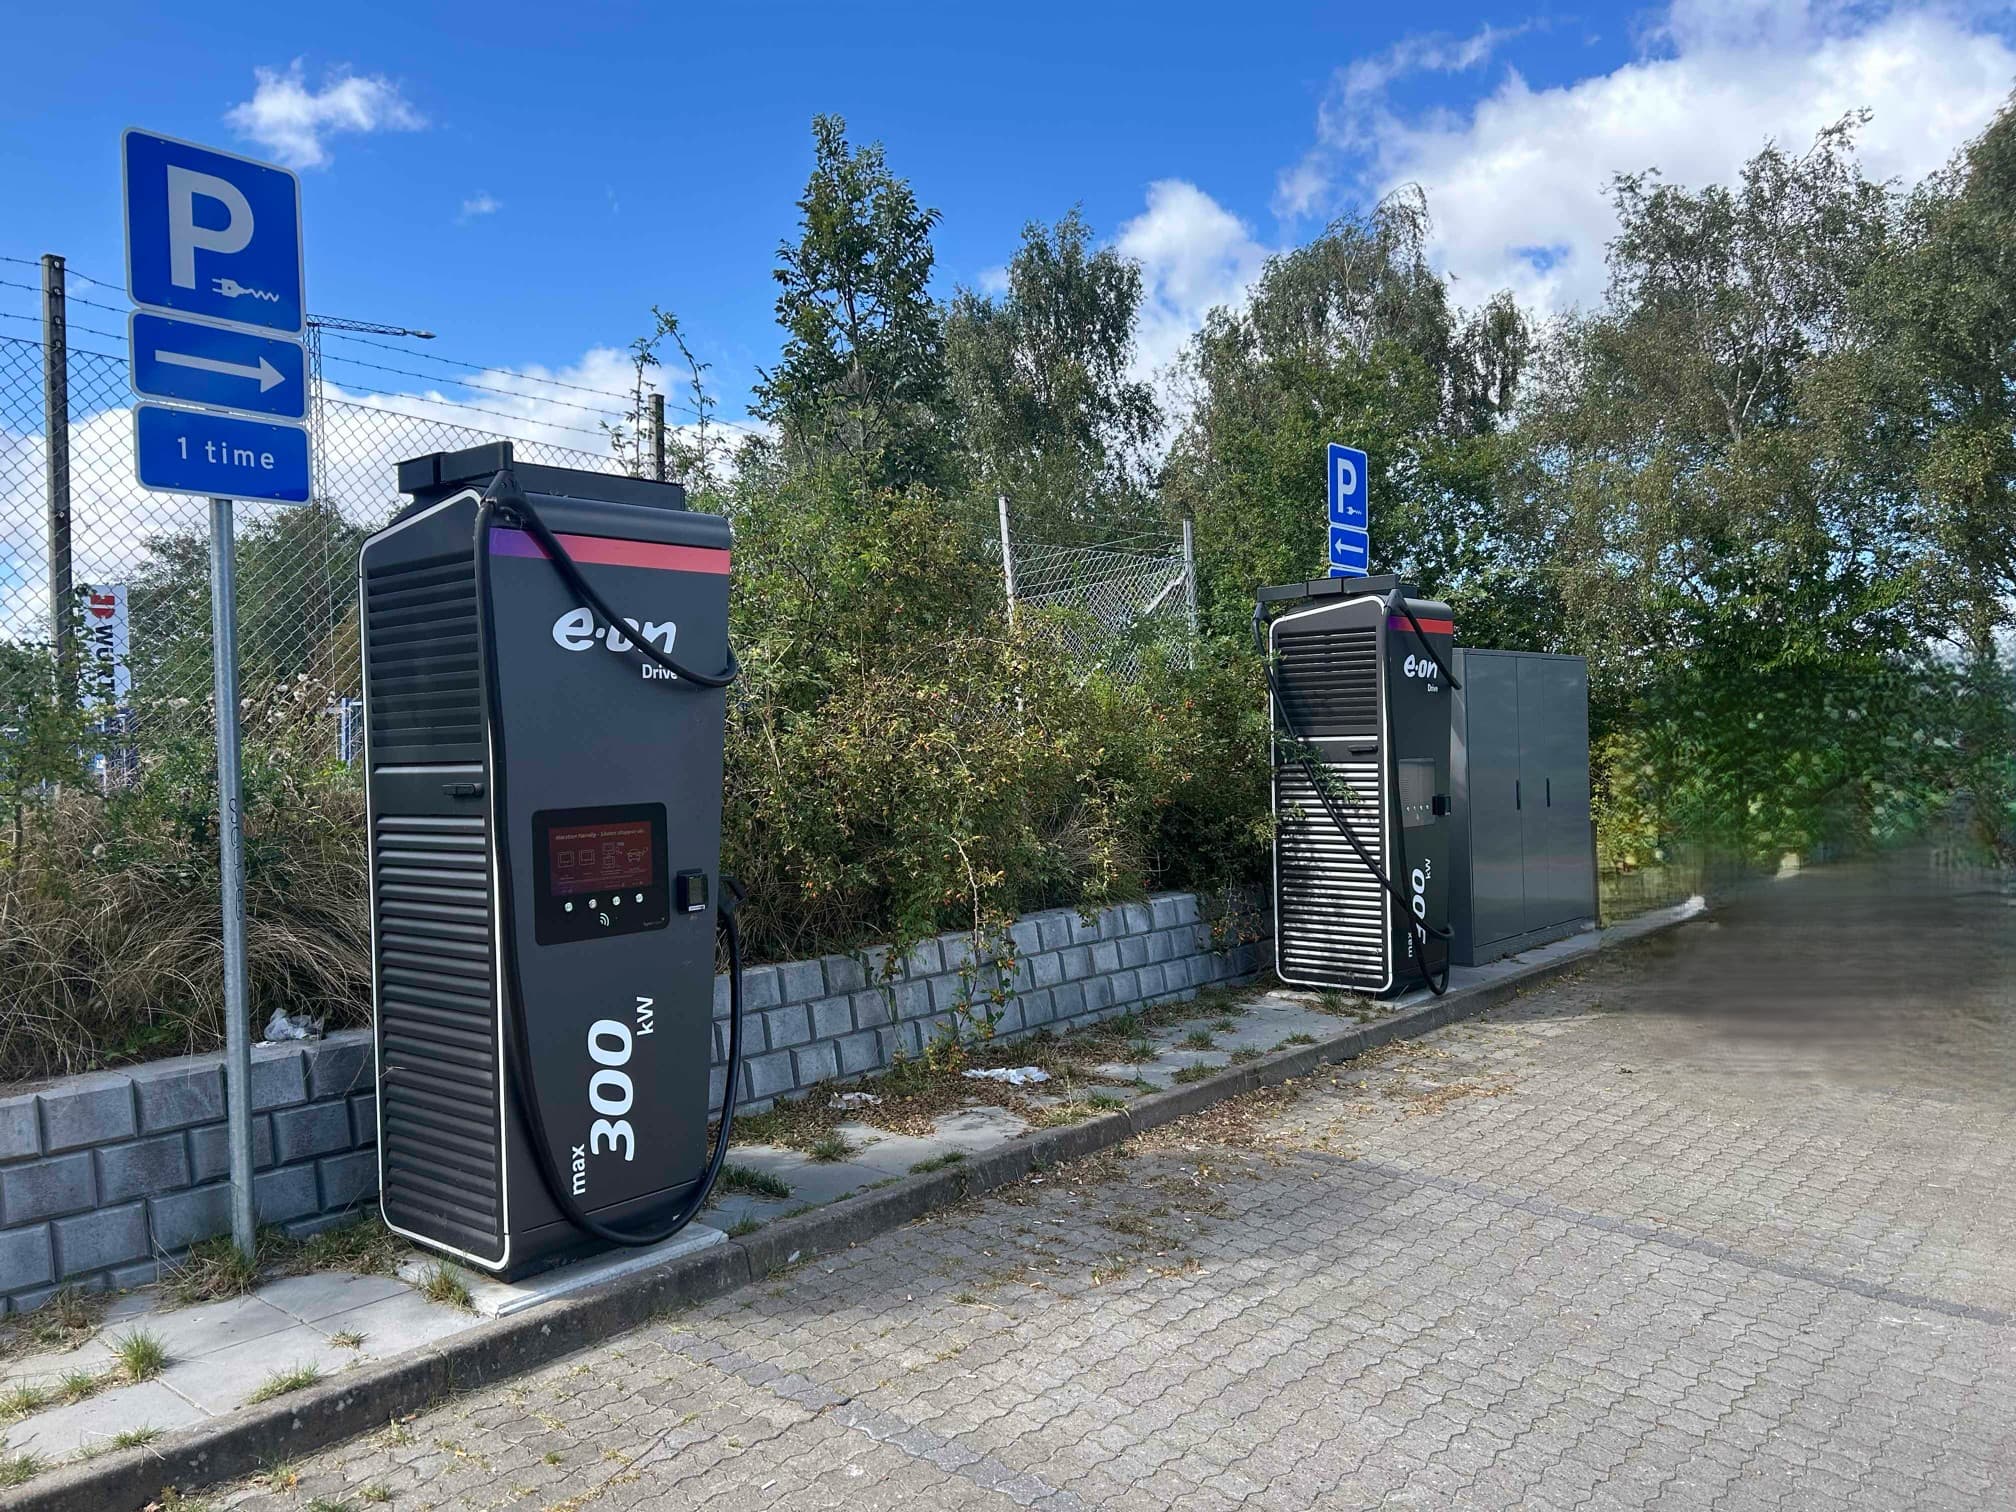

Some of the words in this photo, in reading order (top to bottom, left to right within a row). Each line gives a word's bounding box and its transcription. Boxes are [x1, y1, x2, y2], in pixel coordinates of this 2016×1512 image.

[167, 164, 255, 290] P
[177, 436, 188, 460] 1
[205, 440, 274, 470] time
[1337, 457, 1357, 514] P
[1425, 858, 1432, 880] kW
[572, 1143, 586, 1196] max
[587, 1019, 635, 1162] 300
[636, 996, 654, 1036] kW
